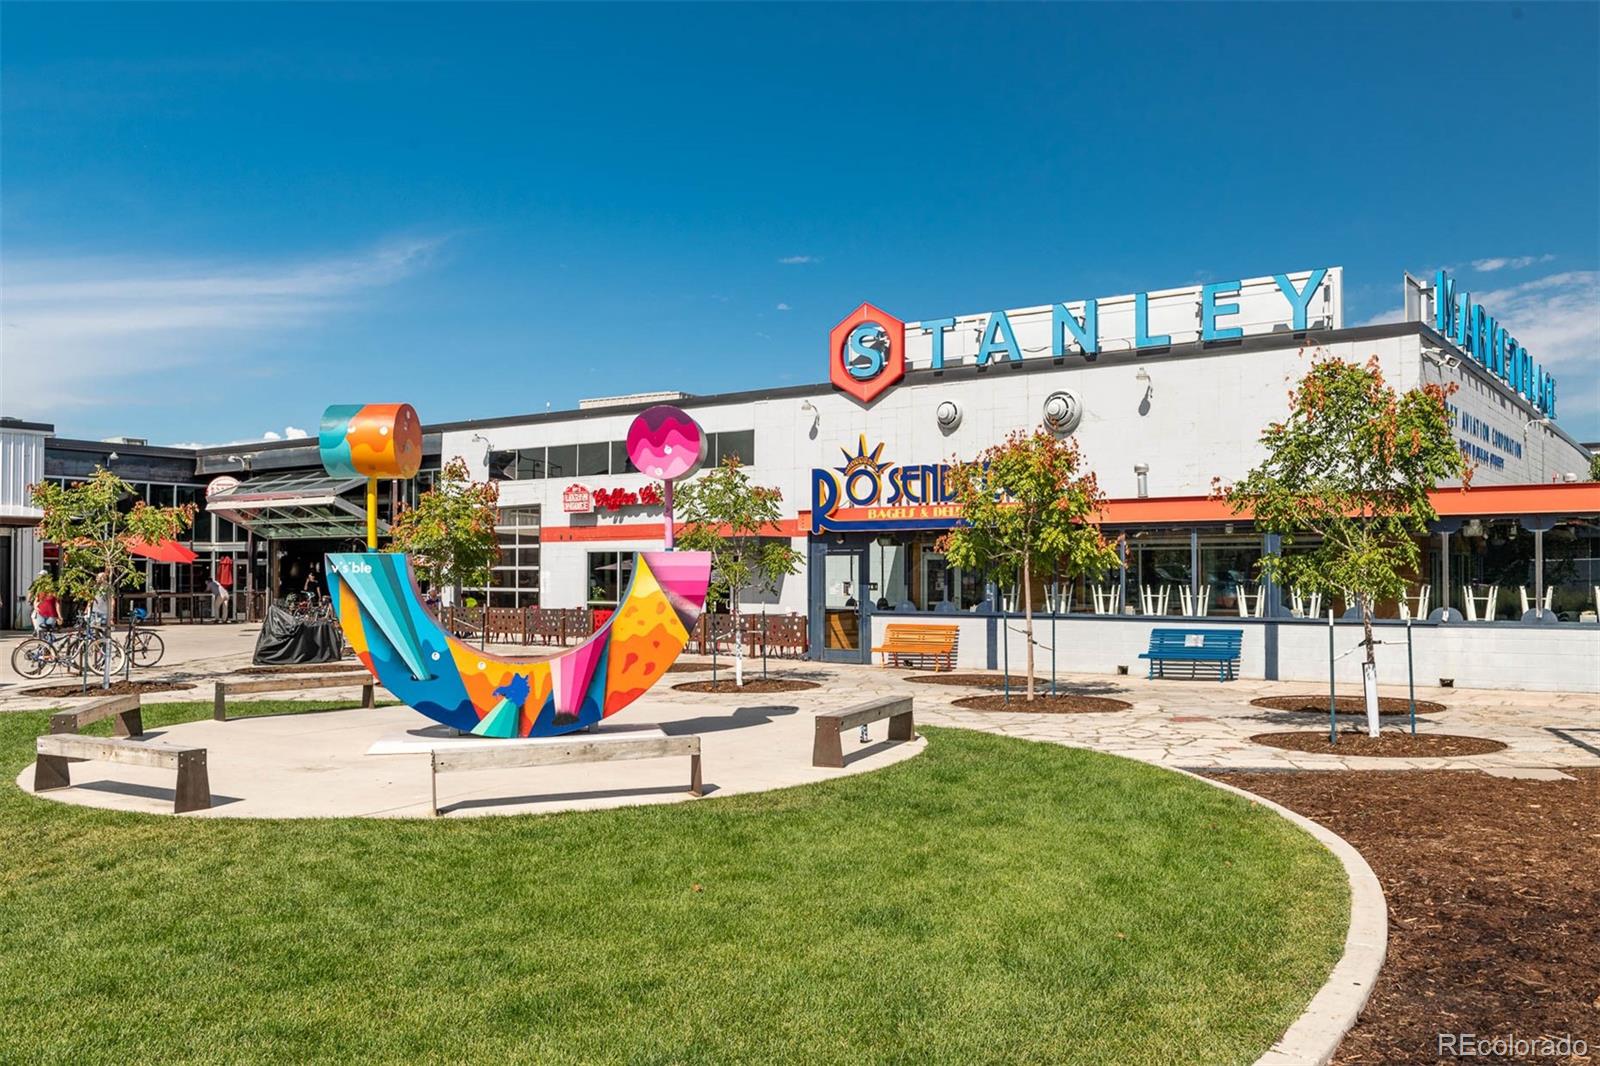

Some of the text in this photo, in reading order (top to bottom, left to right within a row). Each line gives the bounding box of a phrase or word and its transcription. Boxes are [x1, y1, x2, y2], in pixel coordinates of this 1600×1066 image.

[847, 267, 1328, 380] STANLEY
[868, 507, 915, 519] BAGELS
[920, 507, 929, 517] &
